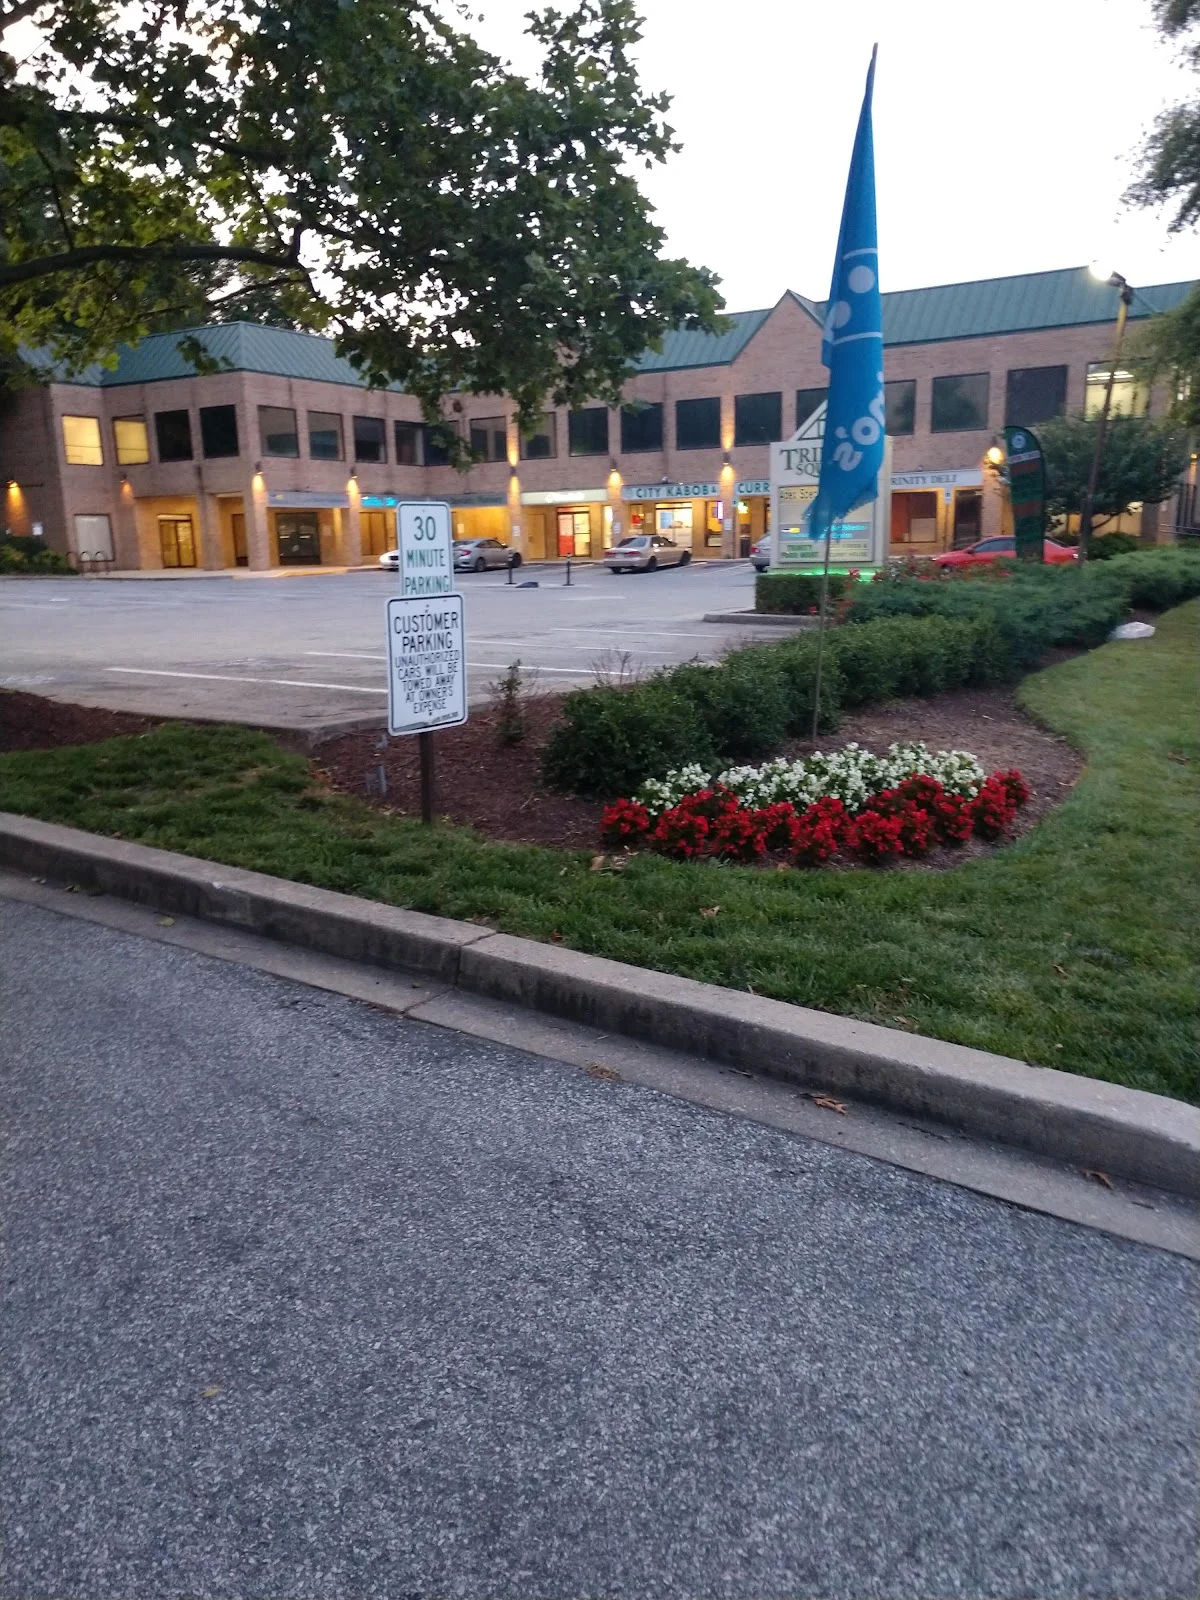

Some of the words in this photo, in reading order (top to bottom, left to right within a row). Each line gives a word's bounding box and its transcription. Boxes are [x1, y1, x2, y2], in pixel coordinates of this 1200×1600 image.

[636, 487, 660, 498] CITY
[667, 484, 709, 497] KABOB
[737, 482, 770, 494] CURR
[891, 475, 927, 486] RINITY
[930, 474, 957, 484] DELI
[414, 515, 436, 541] 30
[406, 548, 446, 569] MINUTE
[404, 575, 450, 595] PARKING
[394, 611, 459, 634] CUSTOMER
[402, 631, 453, 654] PARKING
[395, 649, 460, 669] UNAUTHORIZED
[397, 666, 421, 681] CARS
[424, 663, 445, 677] WILL
[447, 661, 459, 674] BE
[402, 677, 432, 692] TOWED
[434, 673, 455, 688] AWAY
[405, 691, 415, 703] AT
[413, 698, 447, 714] EXPENSE
